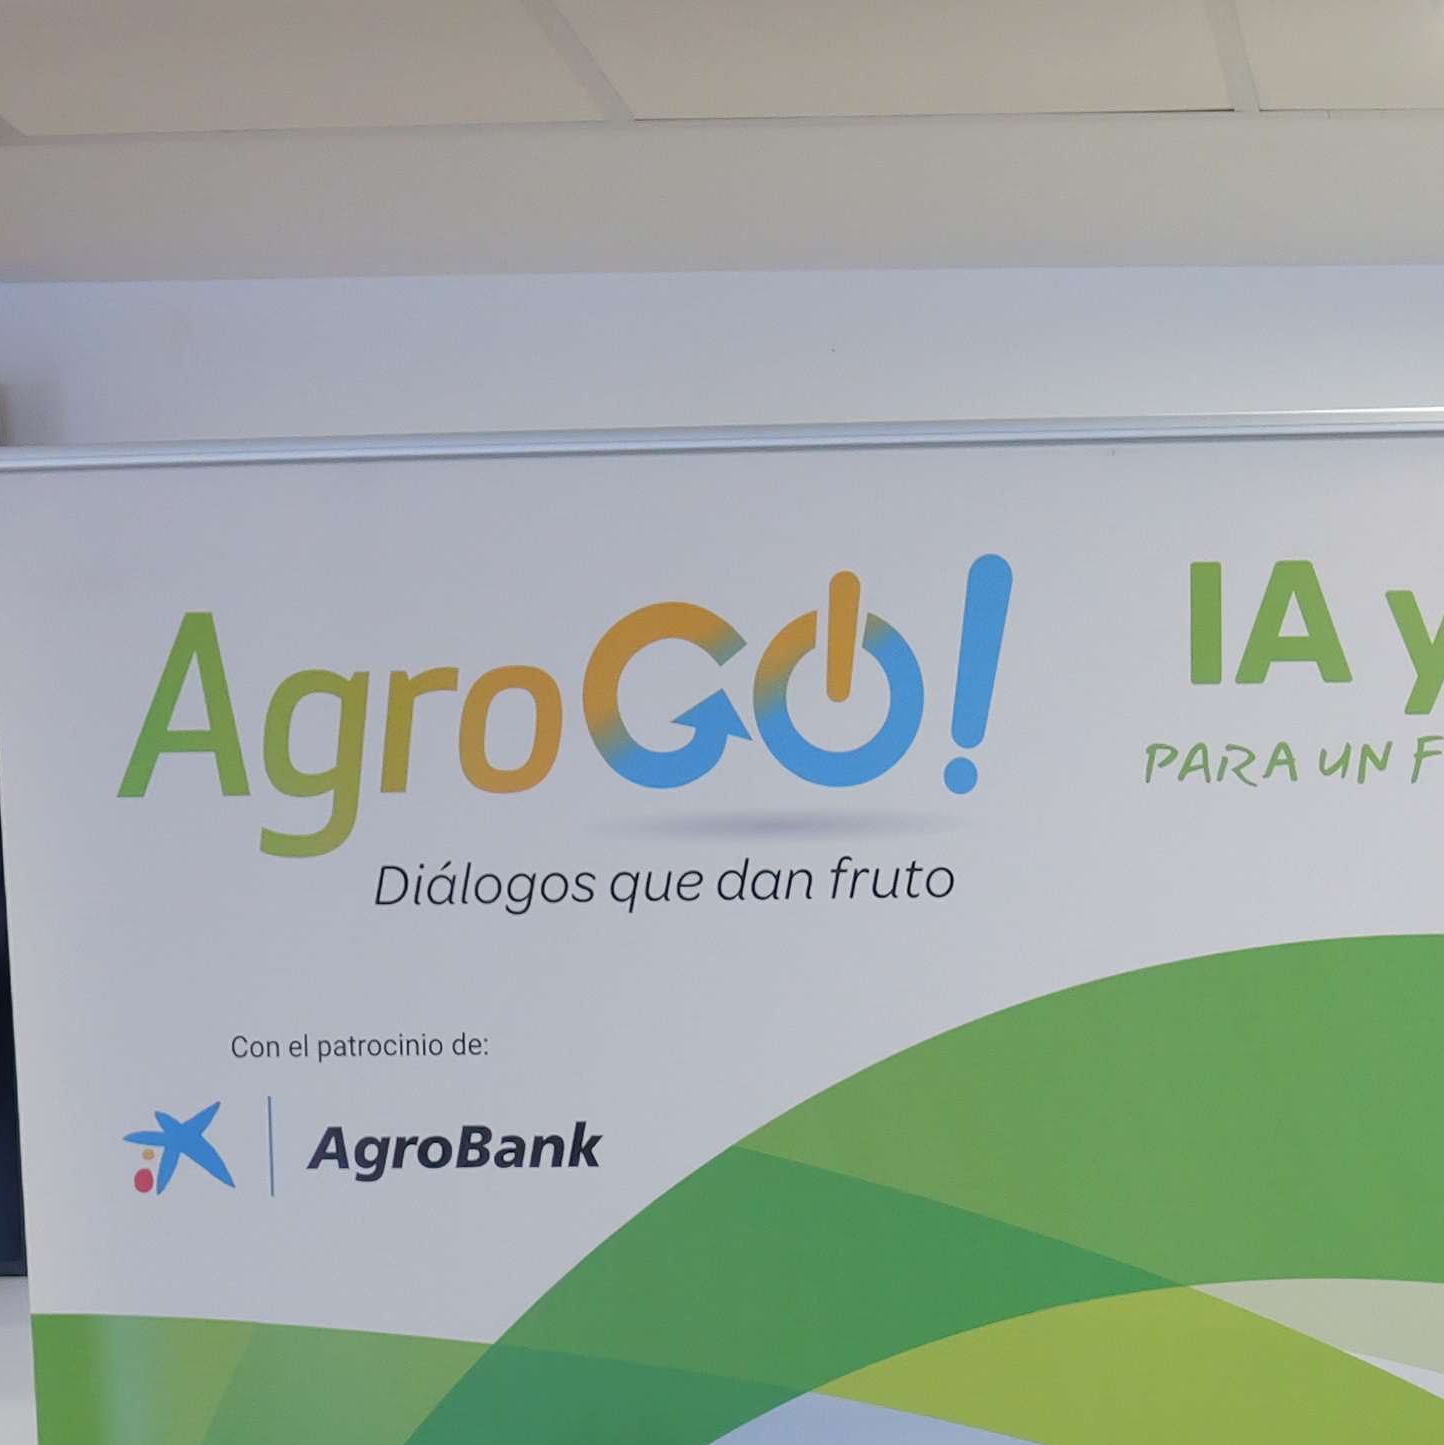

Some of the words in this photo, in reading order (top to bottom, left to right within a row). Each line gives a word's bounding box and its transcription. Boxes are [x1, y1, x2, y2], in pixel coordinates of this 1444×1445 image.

[1189, 559, 1354, 686] IA
[1144, 742, 1299, 787] PARA
[1319, 739, 1392, 784] UN
[373, 860, 597, 915] Diálogos
[609, 868, 705, 914] que
[717, 857, 815, 902] dan
[829, 855, 956, 900] fruto
[231, 1035, 280, 1058] Con
[288, 1034, 309, 1058] el
[317, 1033, 444, 1063] patrocinio
[452, 1032, 490, 1056] de:
[306, 1121, 603, 1183] AgroBank
